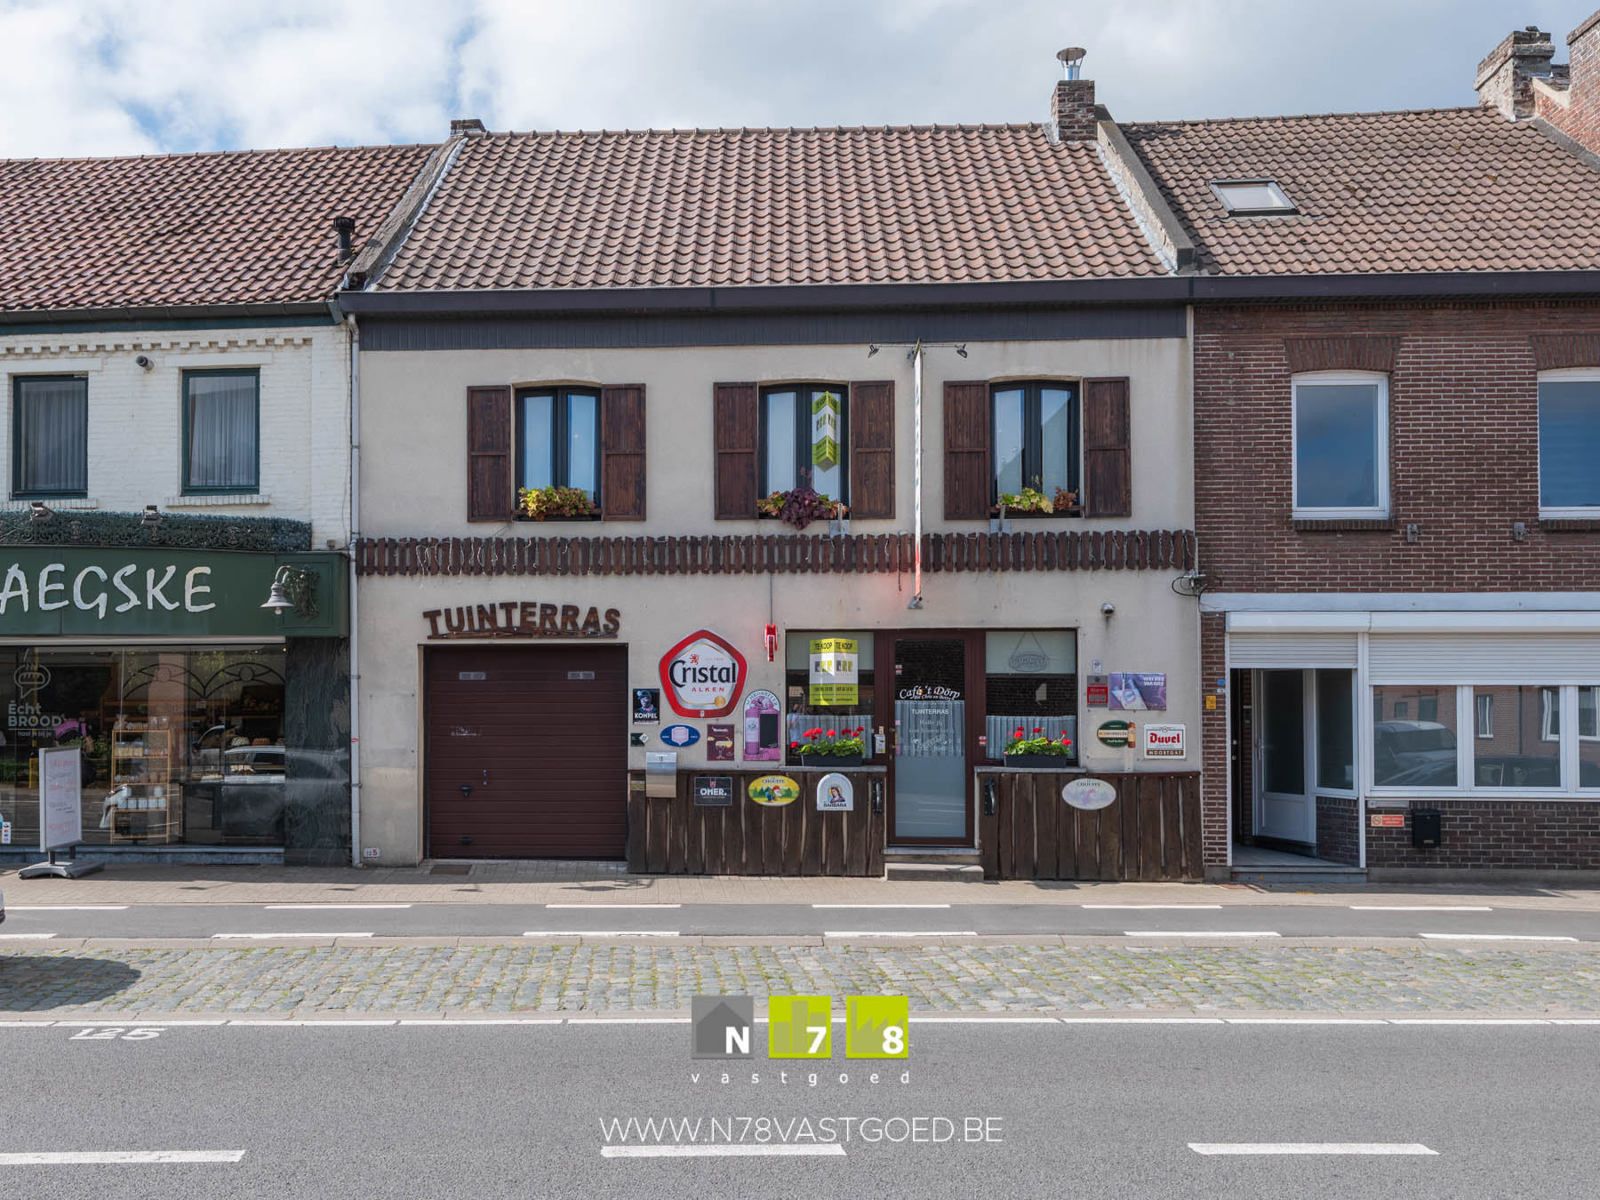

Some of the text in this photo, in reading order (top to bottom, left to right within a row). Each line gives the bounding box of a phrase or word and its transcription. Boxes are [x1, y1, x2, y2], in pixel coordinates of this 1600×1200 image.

[422, 601, 621, 638] TUINTERRAS
[669, 659, 736, 688] Cristal
[1149, 732, 1181, 744] Duvel
